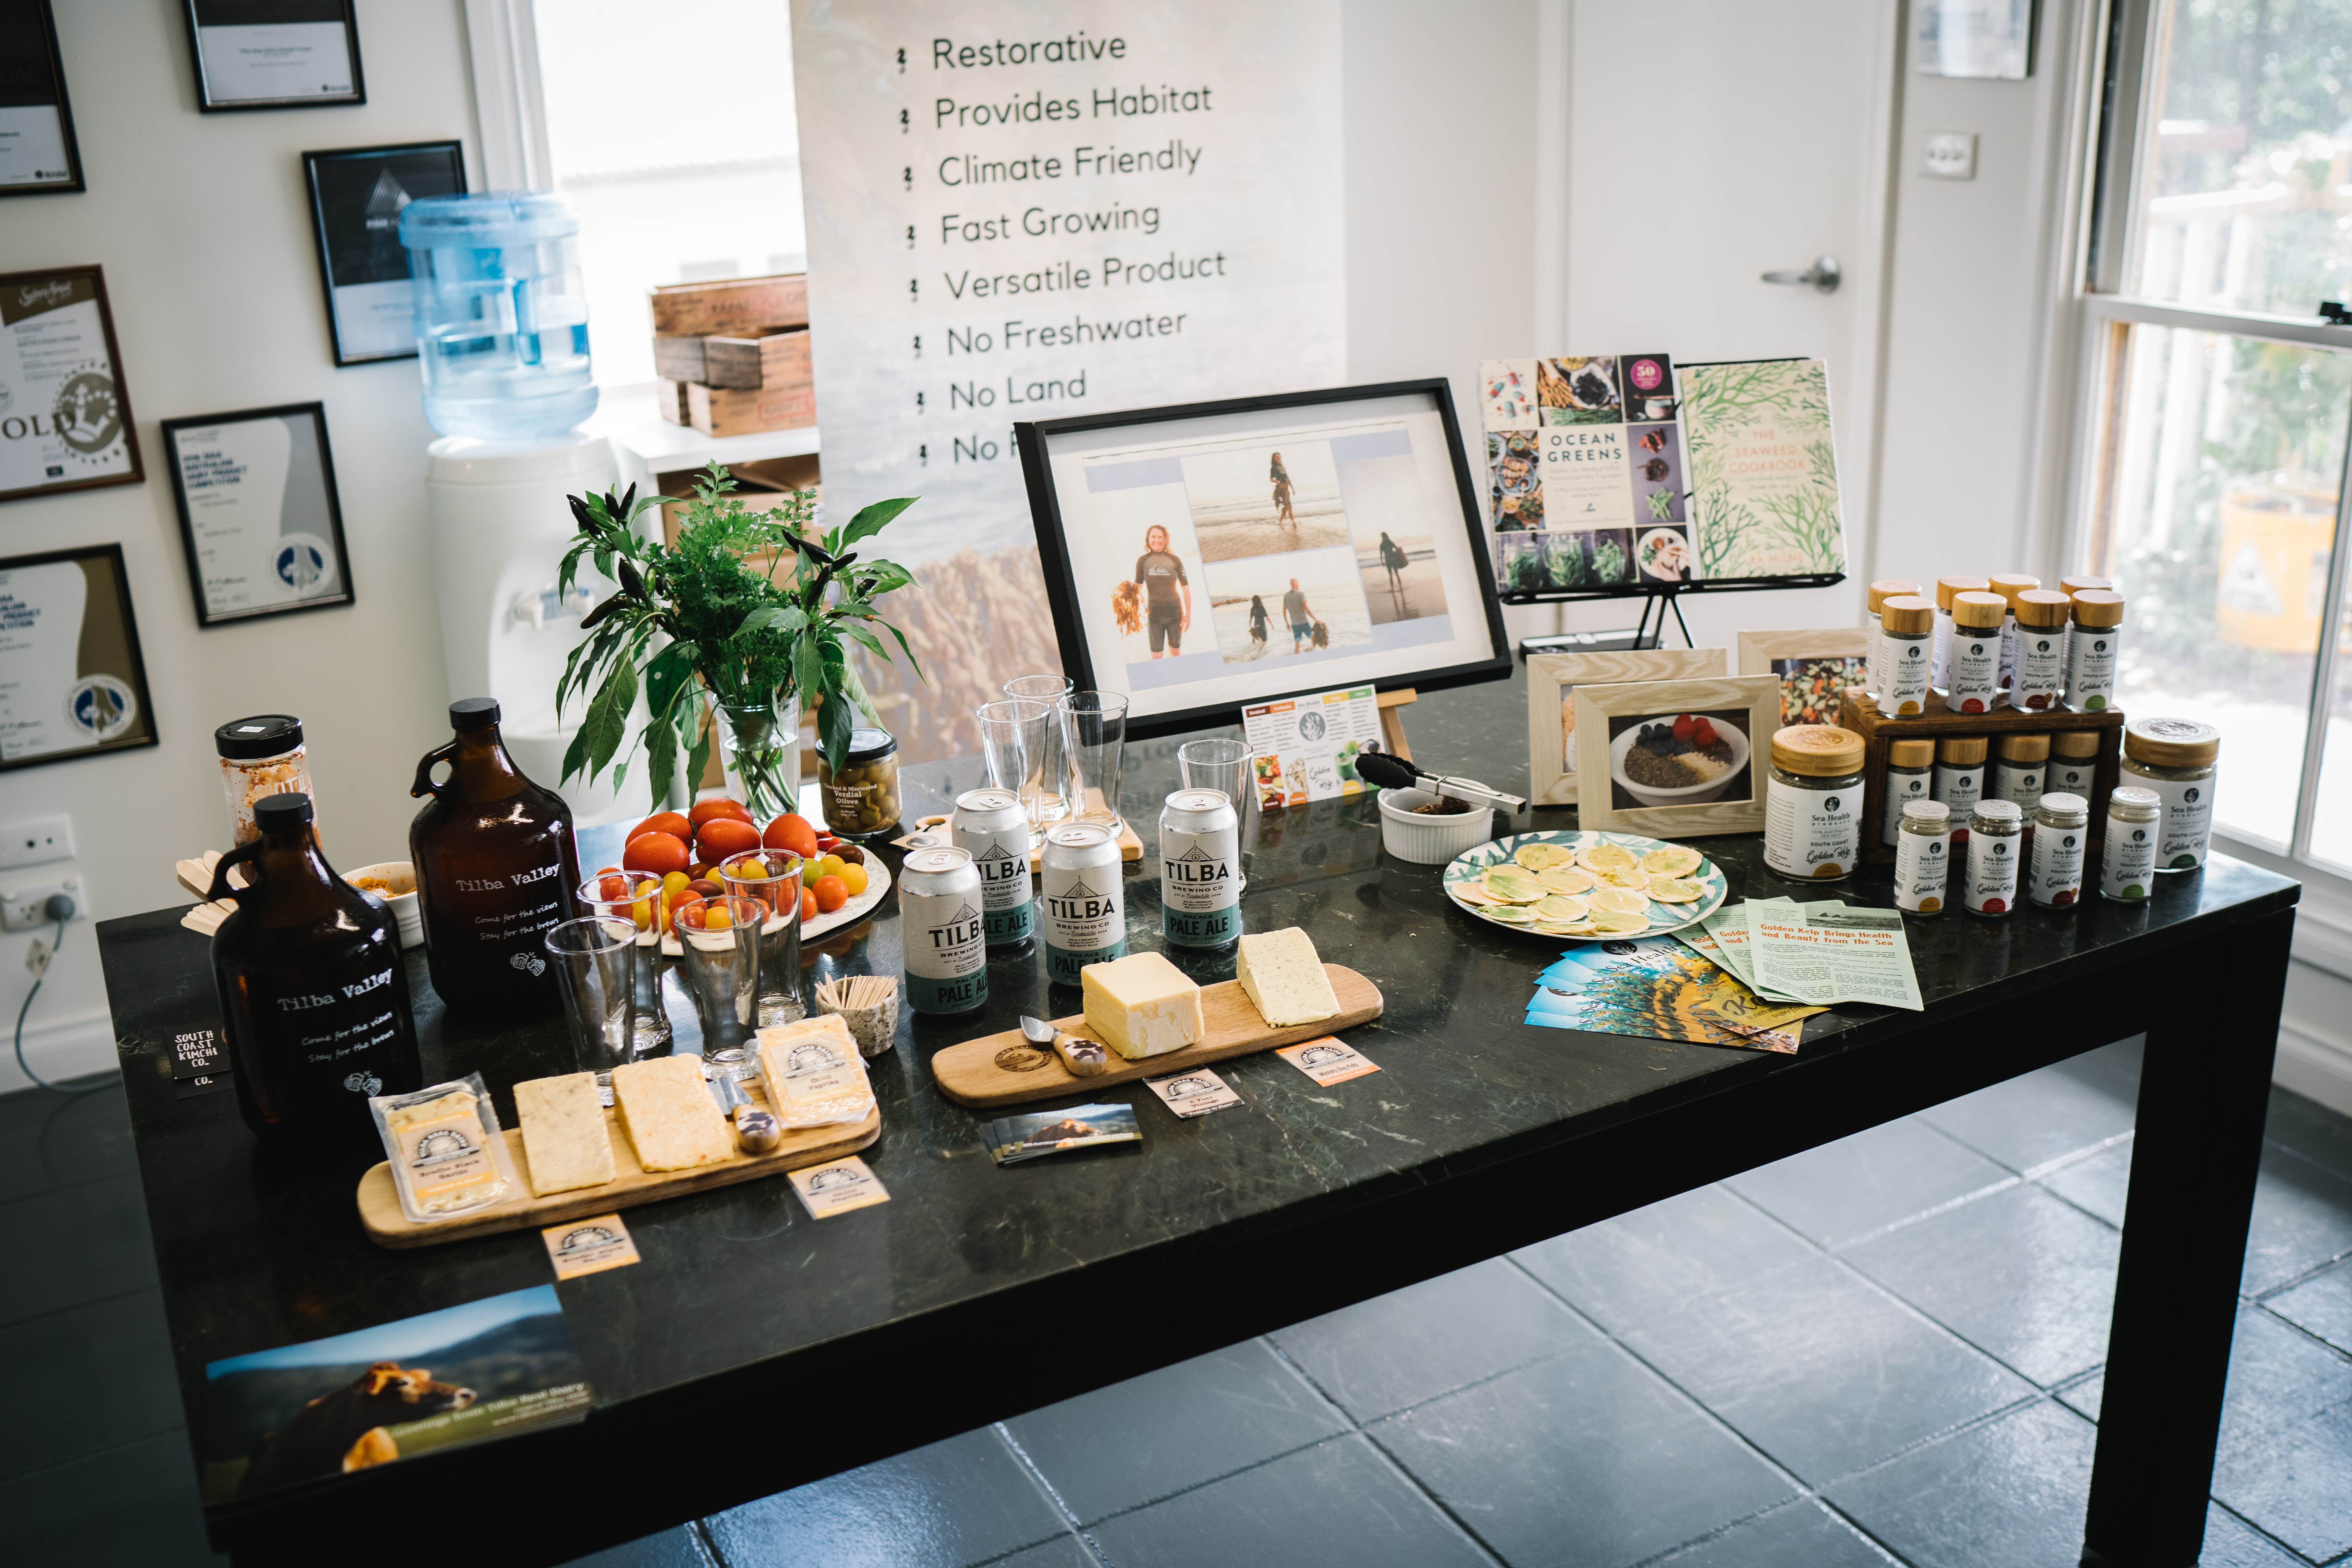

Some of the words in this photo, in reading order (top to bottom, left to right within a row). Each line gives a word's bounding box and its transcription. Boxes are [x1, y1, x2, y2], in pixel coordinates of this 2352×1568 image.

[933, 31, 1127, 69] Restorative
[936, 91, 1081, 129] Provides
[1093, 85, 1212, 118] Habitat
[939, 155, 1061, 186] Climate
[1075, 140, 1201, 176] Friendly
[942, 214, 1010, 244] Fast
[1024, 203, 1160, 236] Growing
[945, 261, 1091, 299] Versatile
[1104, 252, 1226, 286] Product
[948, 326, 993, 355] No
[1005, 314, 1187, 349] Freshwater
[1636, 366, 1656, 377] 50
[951, 381, 996, 410] No
[1008, 370, 1086, 404] Land
[2, 412, 76, 440] OLD
[1551, 432, 1615, 446] OCEAN
[1751, 430, 1775, 440] THE
[954, 435, 998, 464] No
[1548, 448, 1621, 462] GREENS
[1734, 443, 1797, 457] SEAWEED
[1729, 459, 1805, 473] COOKBOOK
[1768, 552, 1803, 563] MILNE
[824, 783, 842, 791] Cracked
[1827, 812, 1850, 821] Health
[1806, 849, 1834, 864] Golden
[456, 879, 505, 891] Tilba
[510, 863, 560, 886] Valley
[976, 858, 1026, 881] ILBA
[1165, 860, 1229, 882] TILBA
[1913, 883, 1935, 895] Golden
[1976, 883, 2000, 895] Golden
[503, 914, 517, 923] for
[519, 909, 534, 918] the
[536, 902, 558, 913] views
[1048, 897, 1115, 919] TILBA
[480, 932, 500, 940] Stay
[503, 930, 517, 939] for
[519, 926, 535, 934] the
[537, 917, 559, 930] brews
[1007, 911, 1027, 933] ALE
[1170, 916, 1200, 936] PALE
[1205, 916, 1229, 936] ALE
[1760, 924, 1794, 933] Golden
[1798, 927, 1819, 936] Kelp
[1824, 930, 1855, 938] Brings
[1784, 933, 1818, 943] Beauty
[940, 944, 978, 958] BREWING
[1054, 955, 1086, 975] PALE
[1605, 963, 1633, 972] Sea
[1629, 946, 1678, 964] Health
[955, 971, 981, 985] PALACE
[277, 994, 336, 1012] Tilba
[341, 968, 392, 999] Valley
[937, 982, 973, 1003] PALE
[1722, 995, 1765, 1016] Ke
[1753, 1005, 1781, 1019] natural
[1771, 1005, 1808, 1018] superfood
[301, 1034, 331, 1046] Come
[334, 1030, 350, 1042] for
[352, 1023, 369, 1035] the
[370, 1011, 393, 1027] views
[174, 1030, 214, 1043] SOUTH
[176, 1038, 215, 1052] COAST
[308, 1053, 332, 1063] Stay
[335, 1047, 350, 1060] for
[352, 1040, 370, 1052] the
[371, 1029, 394, 1045] brews
[1323, 1047, 1343, 1056] DAIRY
[178, 1047, 218, 1061] KIMCHI
[191, 1058, 210, 1067] CO.
[194, 1076, 213, 1086] CO.
[1192, 1078, 1211, 1088] DAIRY
[1191, 1099, 1219, 1107] Vintage
[392, 1416, 450, 1437] Greetings
[452, 1407, 485, 1422] from
[486, 1399, 518, 1411] Tilba
[519, 1390, 548, 1403] Real
[549, 1382, 585, 1396] Dairy
